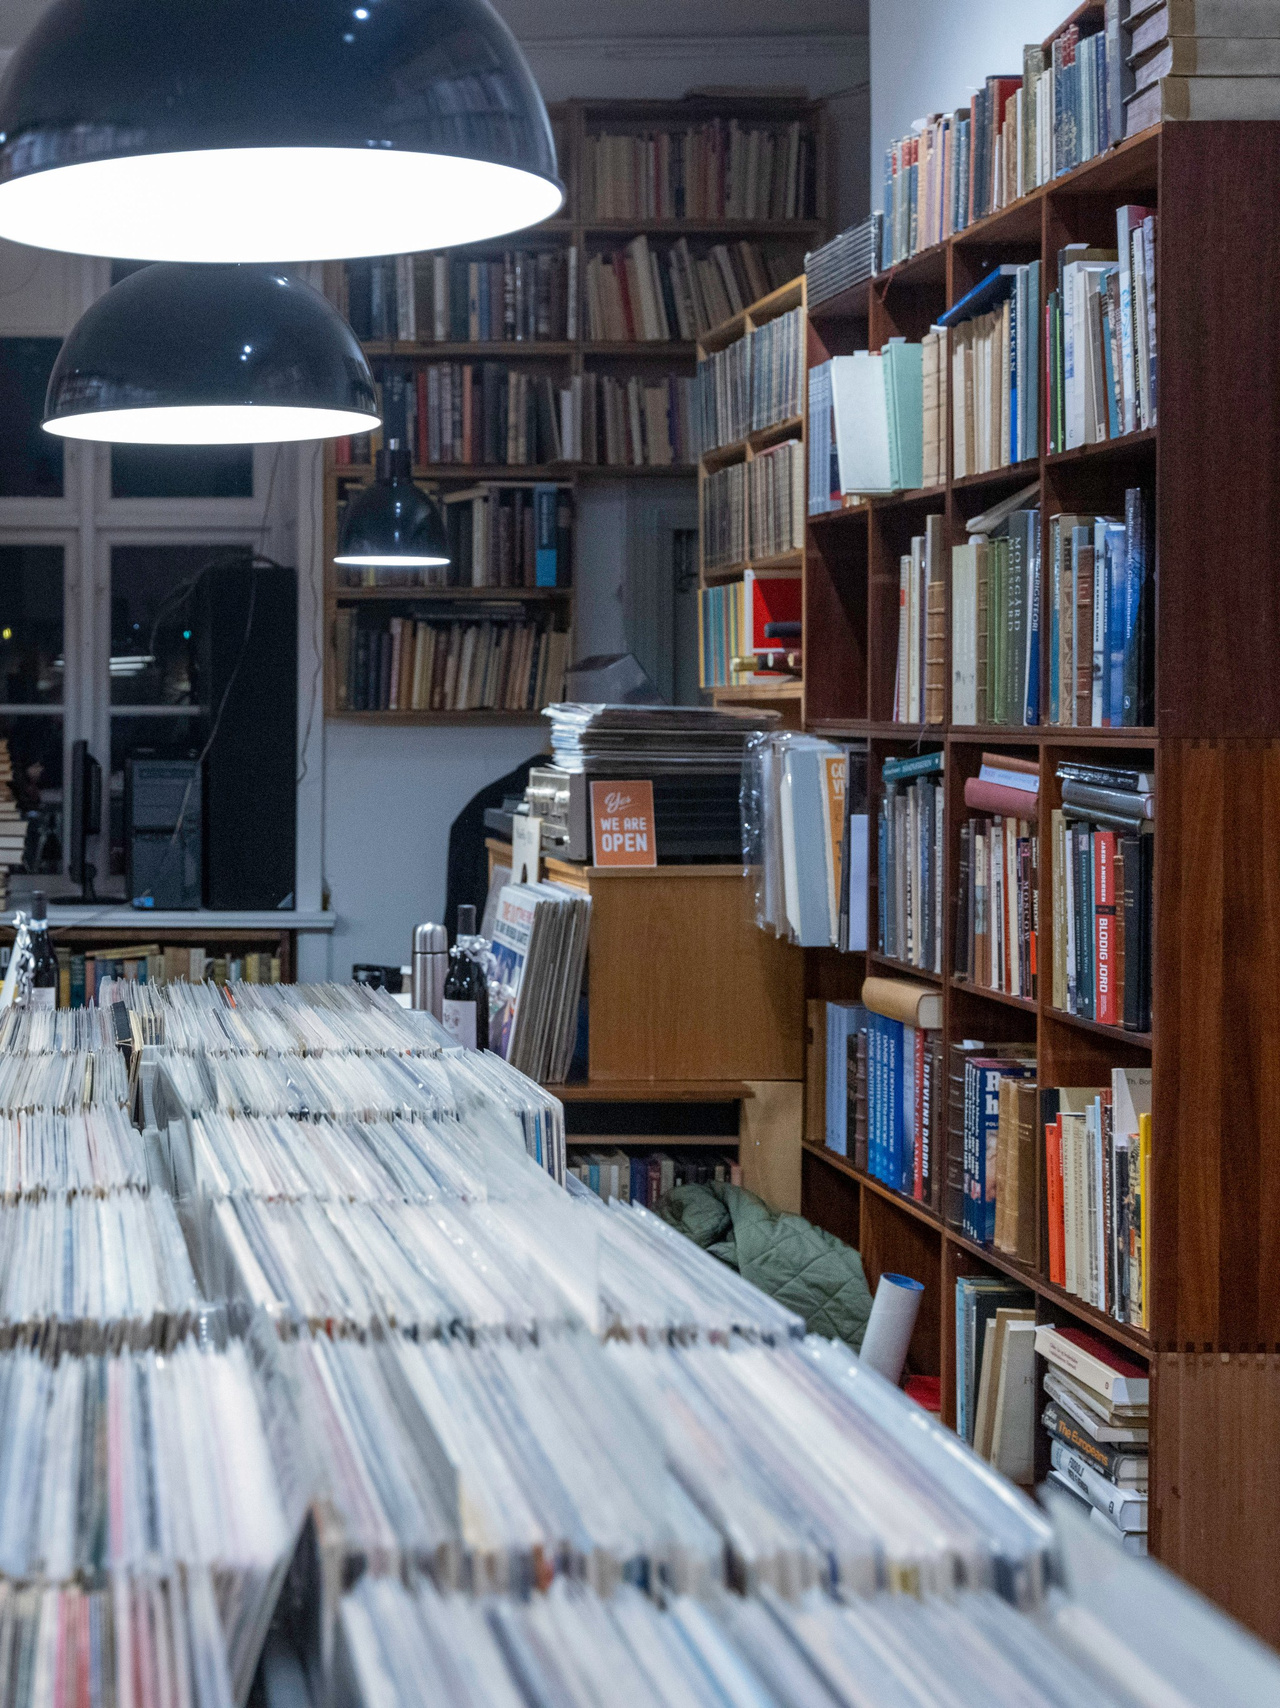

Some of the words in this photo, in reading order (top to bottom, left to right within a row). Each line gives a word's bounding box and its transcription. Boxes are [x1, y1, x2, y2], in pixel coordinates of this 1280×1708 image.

[604, 792, 631, 814] Yes
[600, 817, 620, 830] WE
[624, 817, 647, 830] ARE
[602, 832, 648, 852] OPEN
[1099, 918, 1108, 960] BLODIG
[1099, 962, 1108, 993] JORD
[1058, 1420, 1072, 1439] The
[1071, 1430, 1108, 1466] Europeans
